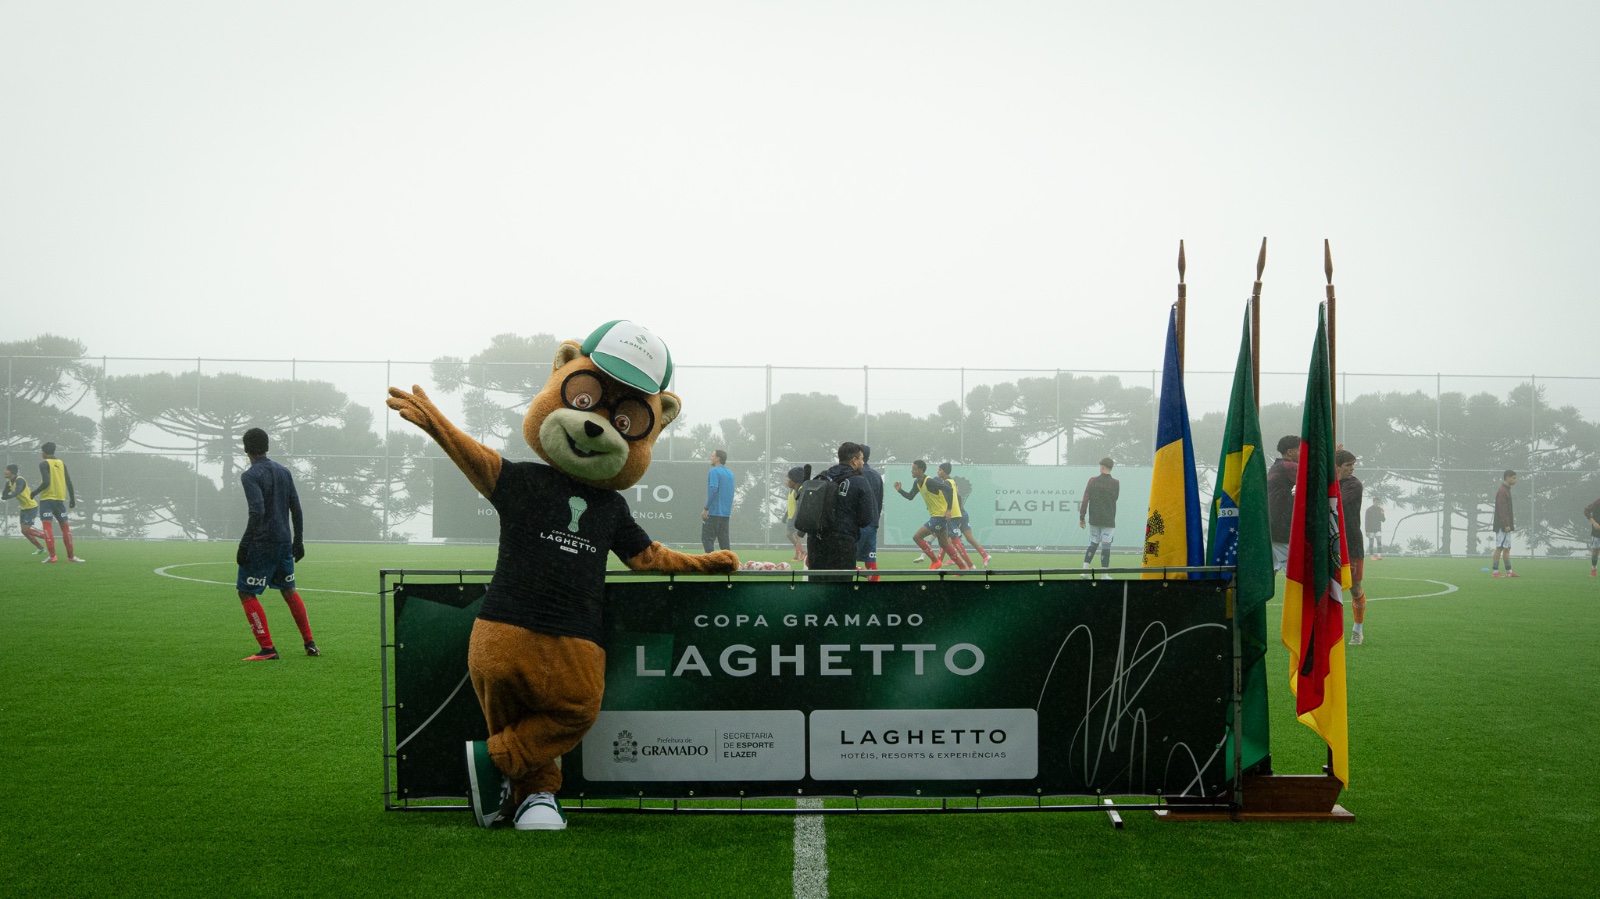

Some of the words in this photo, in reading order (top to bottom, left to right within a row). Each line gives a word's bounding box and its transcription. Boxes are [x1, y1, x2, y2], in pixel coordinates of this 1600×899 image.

[995, 500, 1082, 512] LAGHET
[540, 532, 597, 553] LAGHETTO
[246, 576, 267, 587] axi
[694, 614, 769, 628] COPA
[783, 613, 924, 627] GRAMADO
[635, 643, 985, 677] LAGHETTO
[723, 732, 774, 740] SECRETARIA
[840, 729, 1007, 745] LAGHETTO
[641, 745, 709, 756] GRAMADO
[736, 741, 775, 749] ESPORTE
[840, 751, 879, 760] HOTÉIS,
[937, 751, 1007, 759] EXPERIÊNCIAS
